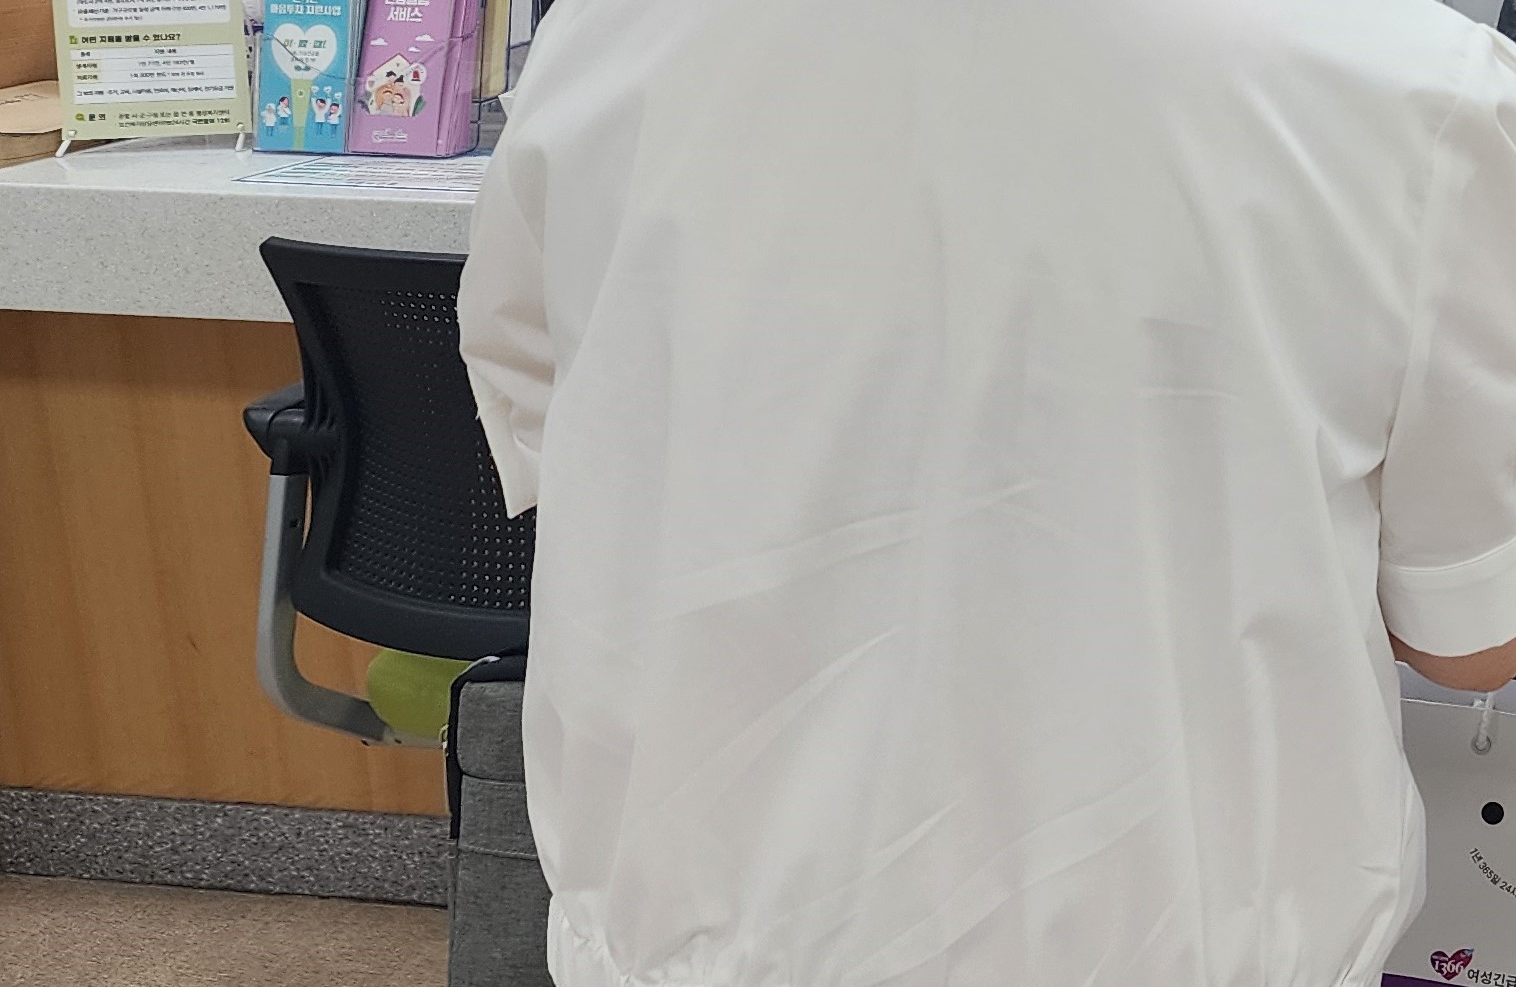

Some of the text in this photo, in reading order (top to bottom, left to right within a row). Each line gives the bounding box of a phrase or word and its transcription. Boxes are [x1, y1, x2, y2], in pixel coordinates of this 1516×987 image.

[387, 6, 423, 22] 서비스
[1469, 848, 1483, 864] 1년
[1478, 862, 1501, 886] 365일
[1435, 959, 1464, 976] 1366
